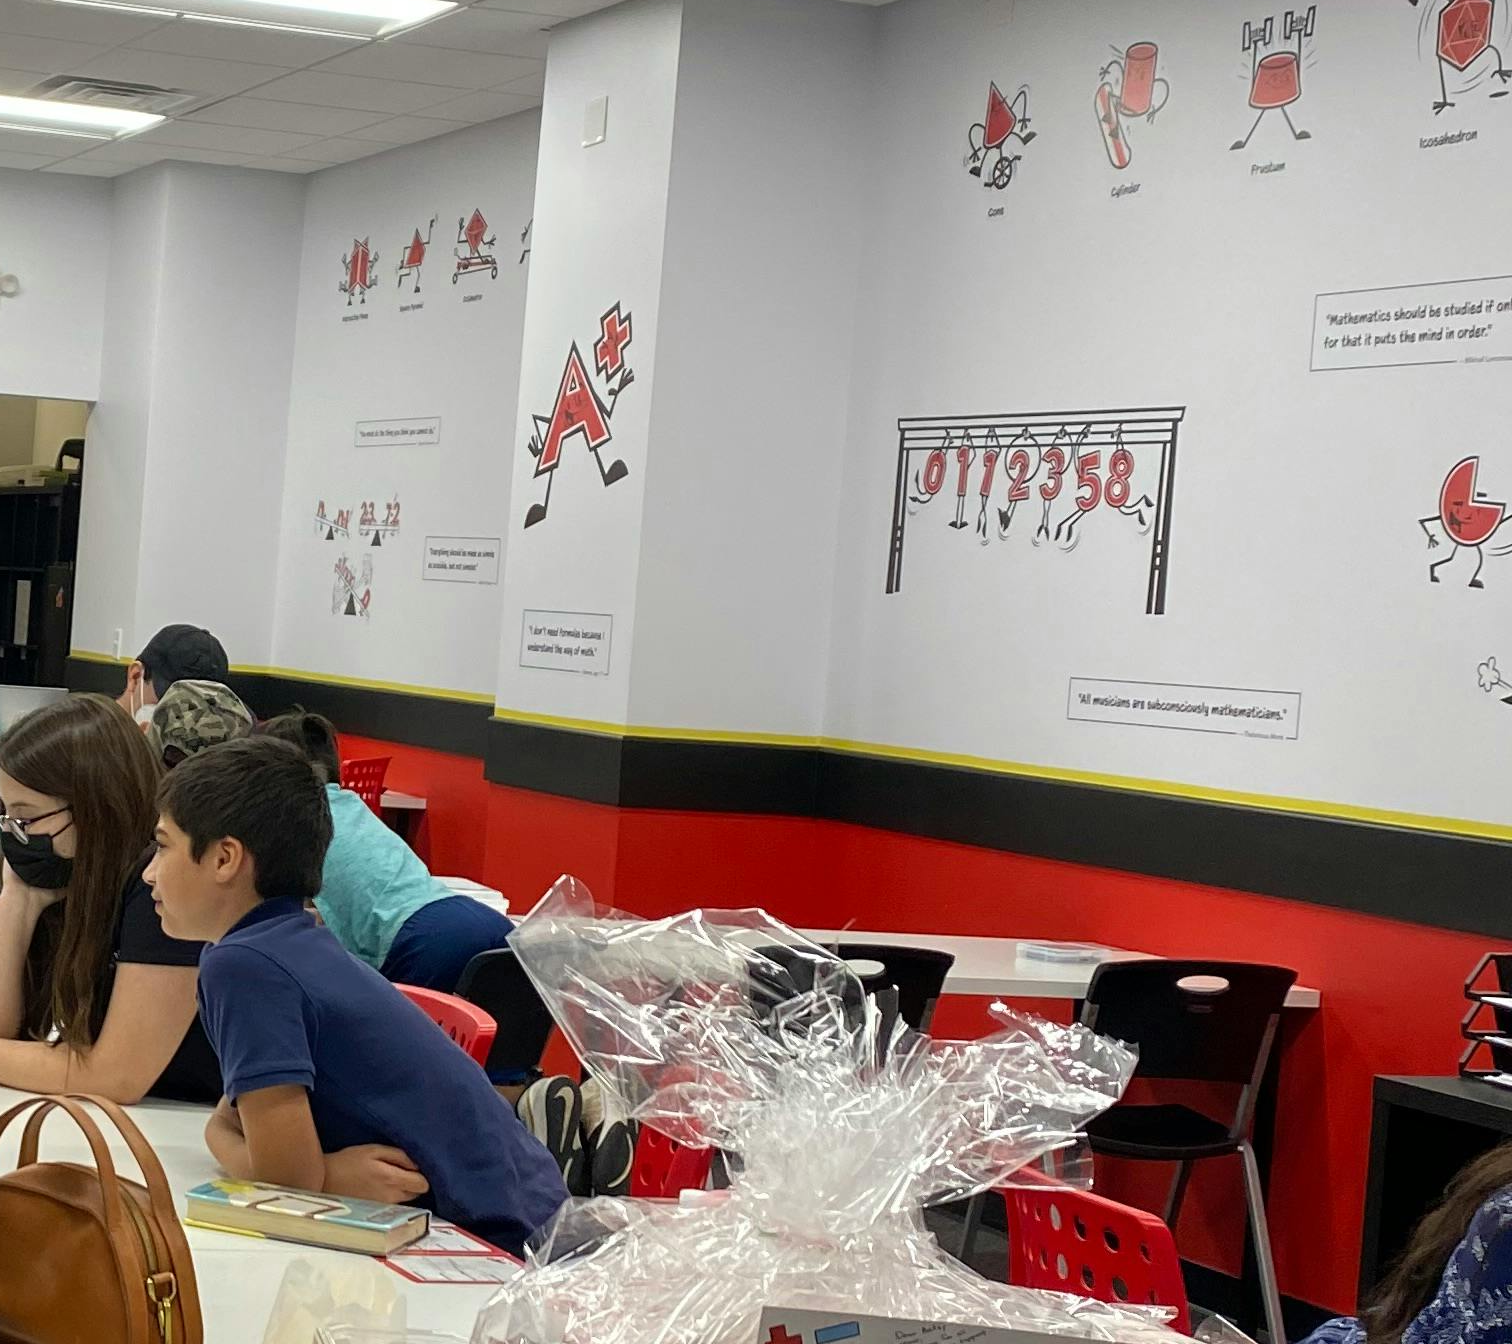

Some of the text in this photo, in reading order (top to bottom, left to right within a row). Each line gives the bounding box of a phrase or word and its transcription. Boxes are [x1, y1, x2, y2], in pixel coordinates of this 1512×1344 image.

[1419, 130, 1478, 148] Icosahedron
[1251, 161, 1286, 176] Frustum
[1111, 183, 1141, 198] Cylinder
[988, 207, 1004, 218] Cone
[1394, 305, 1426, 322] should
[1429, 304, 1441, 318] be
[1444, 300, 1482, 317] studied
[1485, 299, 1494, 312] if
[1496, 298, 1512, 312] onl
[1324, 336, 1338, 349] for
[1342, 334, 1362, 348] that
[1364, 333, 1371, 346] it
[1374, 332, 1396, 347] puts
[1400, 330, 1416, 343] the
[1418, 326, 1442, 342] mind
[1446, 326, 1455, 340] in
[1092, 694, 1130, 709] musicians
[1132, 698, 1145, 710] are
[1147, 698, 1209, 716] subconsciously
